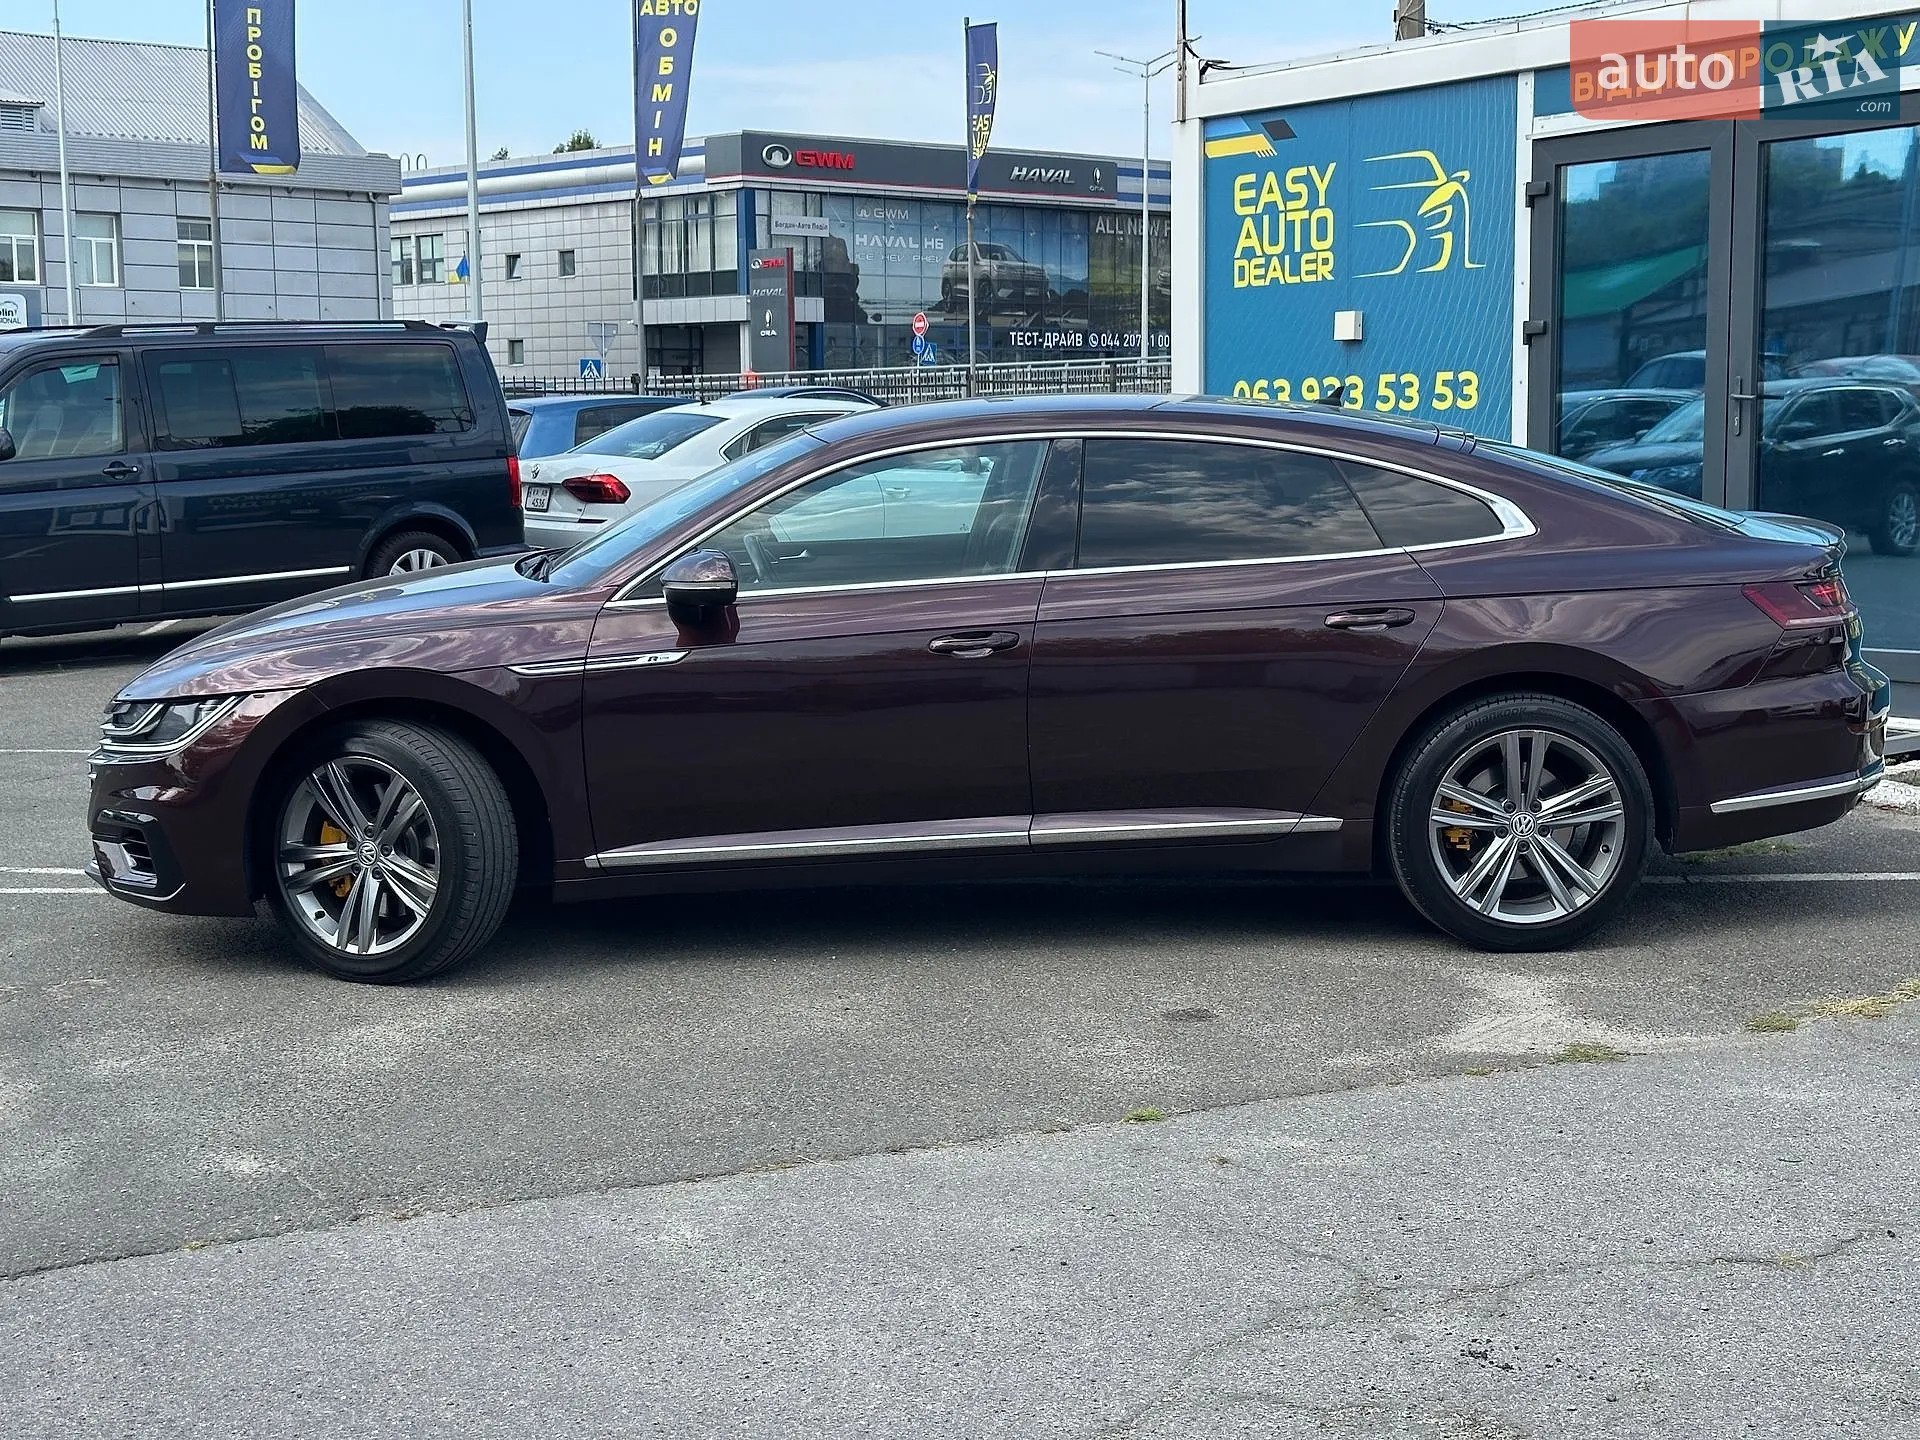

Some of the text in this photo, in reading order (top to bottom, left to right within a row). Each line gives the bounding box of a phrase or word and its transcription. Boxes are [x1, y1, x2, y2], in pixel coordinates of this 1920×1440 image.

[640, 0, 698, 16] АВТО
[246, 7, 268, 151] ПРОБІГОМ
[648, 27, 678, 157] ОБМІН
[795, 149, 855, 169] GWM
[1009, 166, 1076, 184] HAVAL
[1234, 162, 1337, 216] EASY
[873, 207, 909, 220] GWM
[1095, 215, 1124, 235] ALL
[1233, 207, 1334, 258] AUTO
[855, 233, 944, 250] HAVAL H6
[1233, 250, 1335, 289] DEALER
[752, 287, 785, 297] HAVAL
[760, 329, 777, 337] ORA
[1009, 330, 1083, 349] ТЕСТ-ДРАЙВ
[1100, 334, 1120, 347] 044
[1123, 334, 1142, 347] 207
[1158, 334, 1170, 348] 00
[1375, 372, 1420, 412] 53
[1431, 370, 1480, 411] 53
